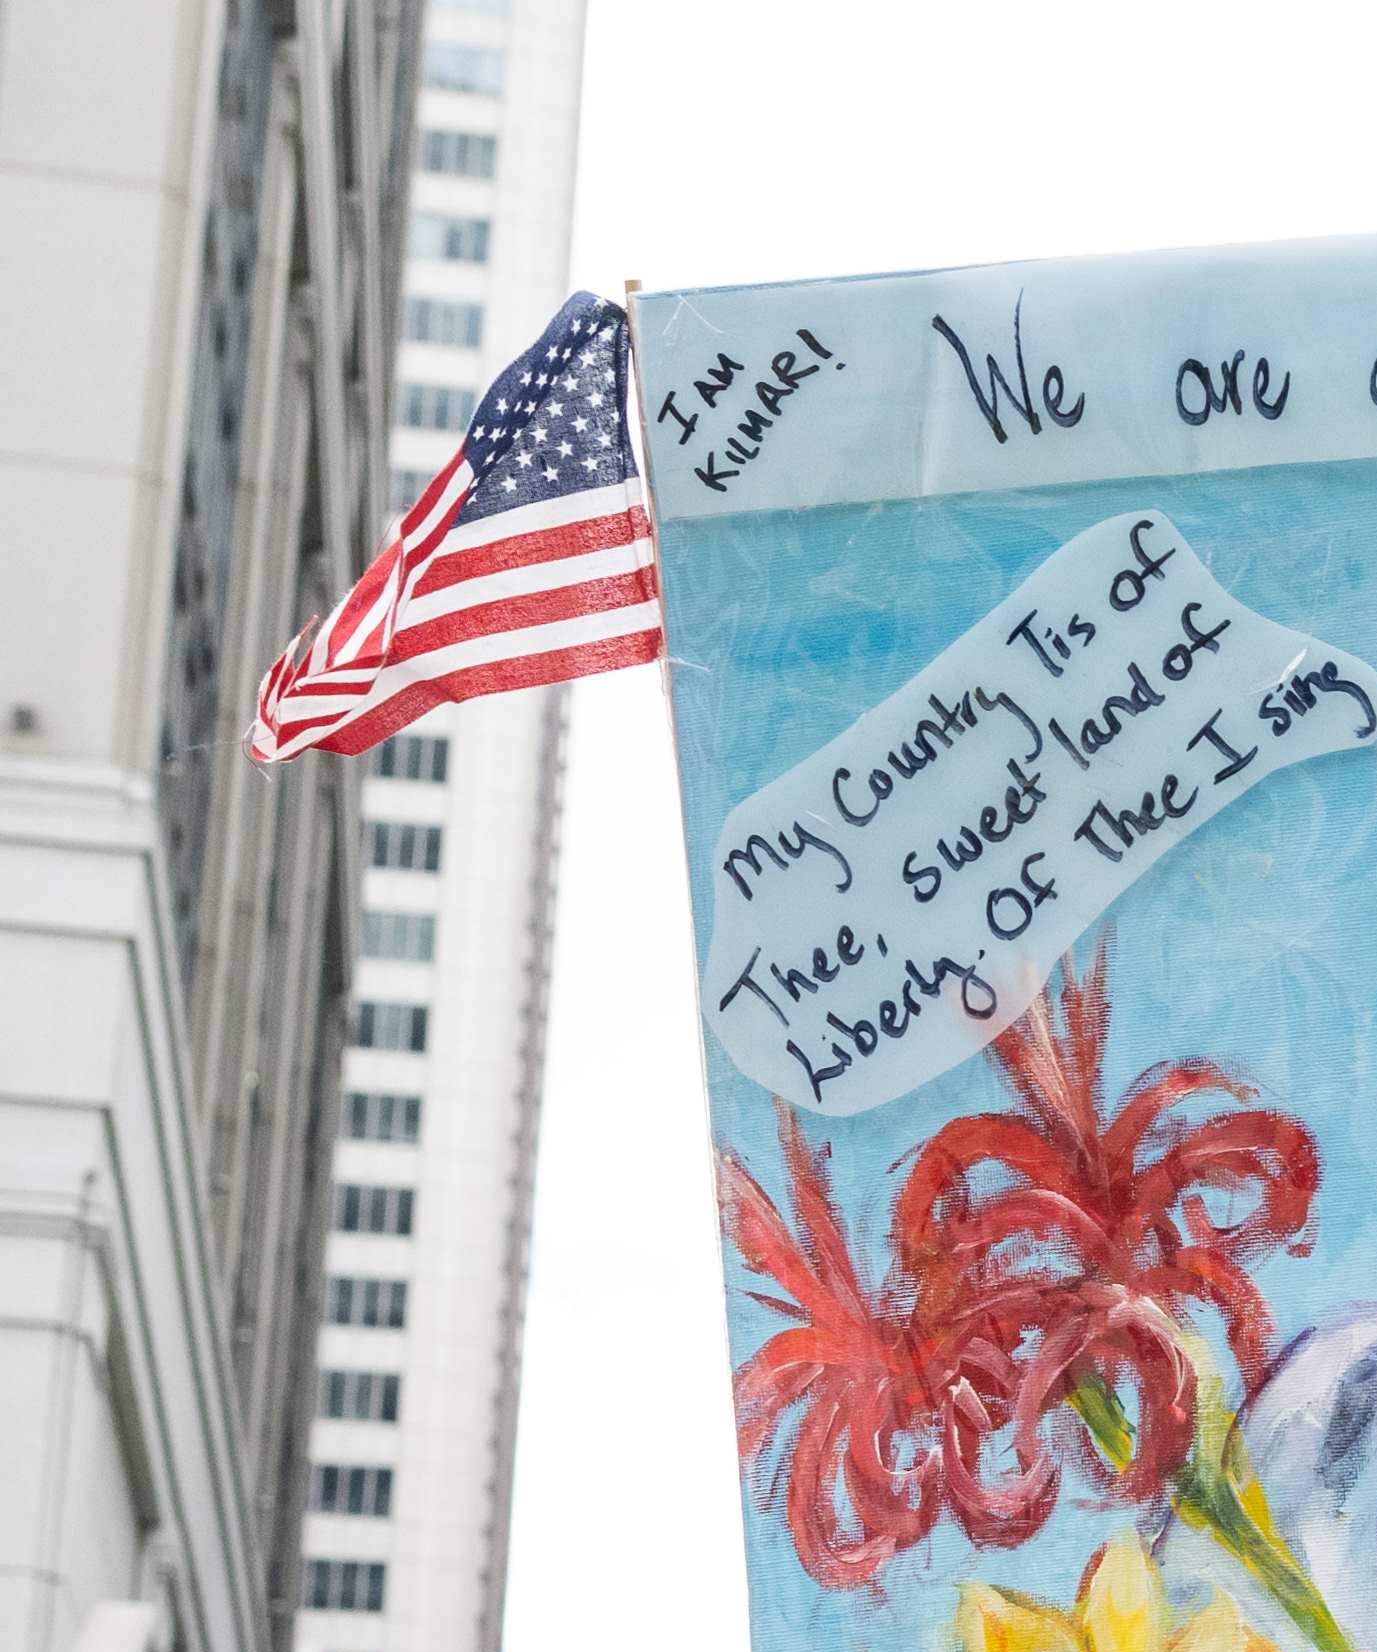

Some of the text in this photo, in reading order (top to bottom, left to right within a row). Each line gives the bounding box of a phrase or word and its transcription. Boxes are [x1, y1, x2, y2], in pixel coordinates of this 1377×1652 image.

[657, 353, 744, 445] I AM
[694, 329, 846, 492] KILMAR!
[932, 288, 1085, 444] We
[1176, 349, 1290, 426] are
[832, 686, 1043, 826] Country
[1006, 609, 1096, 677] Tis
[1109, 520, 1176, 611] of
[1074, 774, 1199, 864] Thee
[1187, 709, 1258, 786] I
[1258, 660, 1377, 738] sing
[719, 924, 889, 1026] Thee,
[1049, 663, 1165, 770] land
[1162, 603, 1231, 681] of
